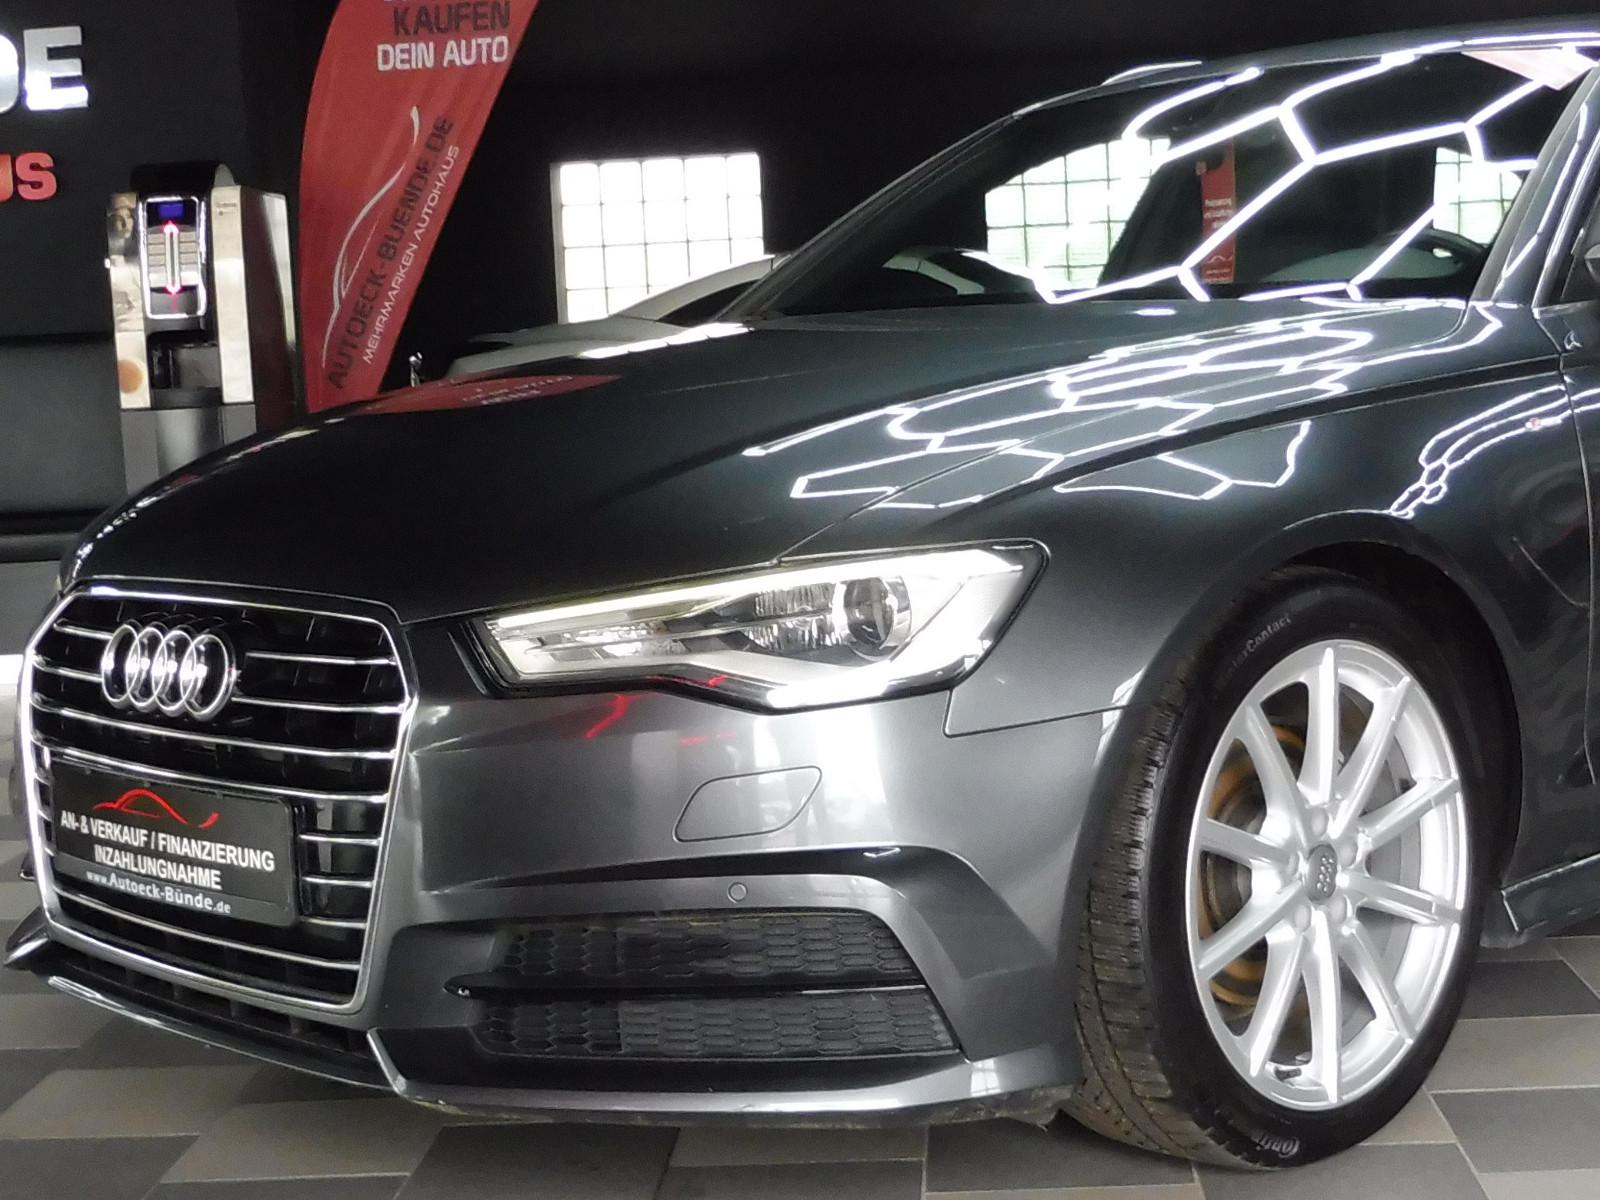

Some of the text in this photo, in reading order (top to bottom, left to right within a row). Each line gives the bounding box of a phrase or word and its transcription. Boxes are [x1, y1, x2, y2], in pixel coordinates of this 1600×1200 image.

[393, 1, 511, 36] KAUFEN
[377, 35, 509, 71] DEIN AUTO
[363, 145, 459, 364] MEHRMARKEN AUTOHAUS
[61, 810, 80, 831] AN-
[80, 815, 90, 834] &
[90, 817, 149, 848] VERKAUF
[158, 832, 276, 872] FINANZIERUNG
[94, 844, 223, 890] INZAHLUNGNAHME
[86, 871, 232, 914] www.Autoeck-Bünde.de
